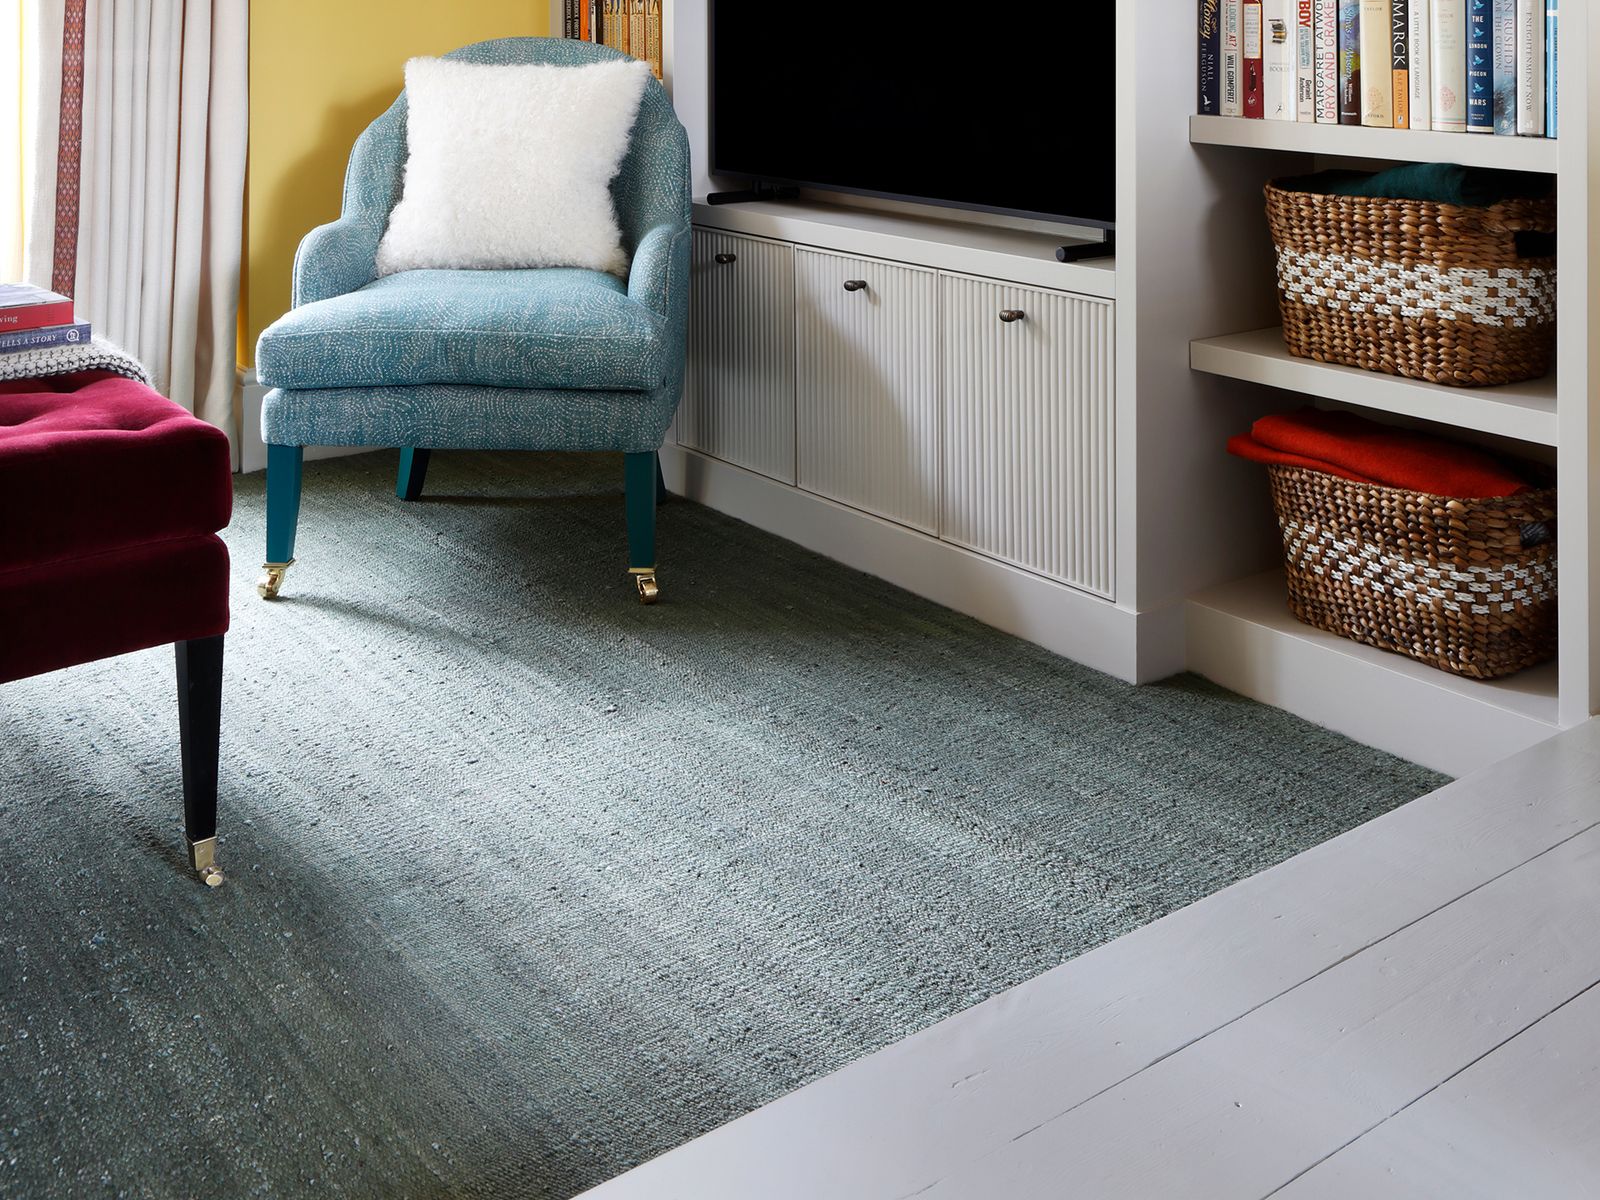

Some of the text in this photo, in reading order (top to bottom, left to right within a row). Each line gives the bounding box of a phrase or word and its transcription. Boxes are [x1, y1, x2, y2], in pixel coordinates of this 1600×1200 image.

[1229, 35, 1237, 47] AT?
[1324, 2, 1335, 119] ORYX AND CRAKE
[1503, 18, 1513, 76] RUSHDIE
[1316, 46, 1324, 118] MARGARET
[30, 334, 57, 344] STORY
